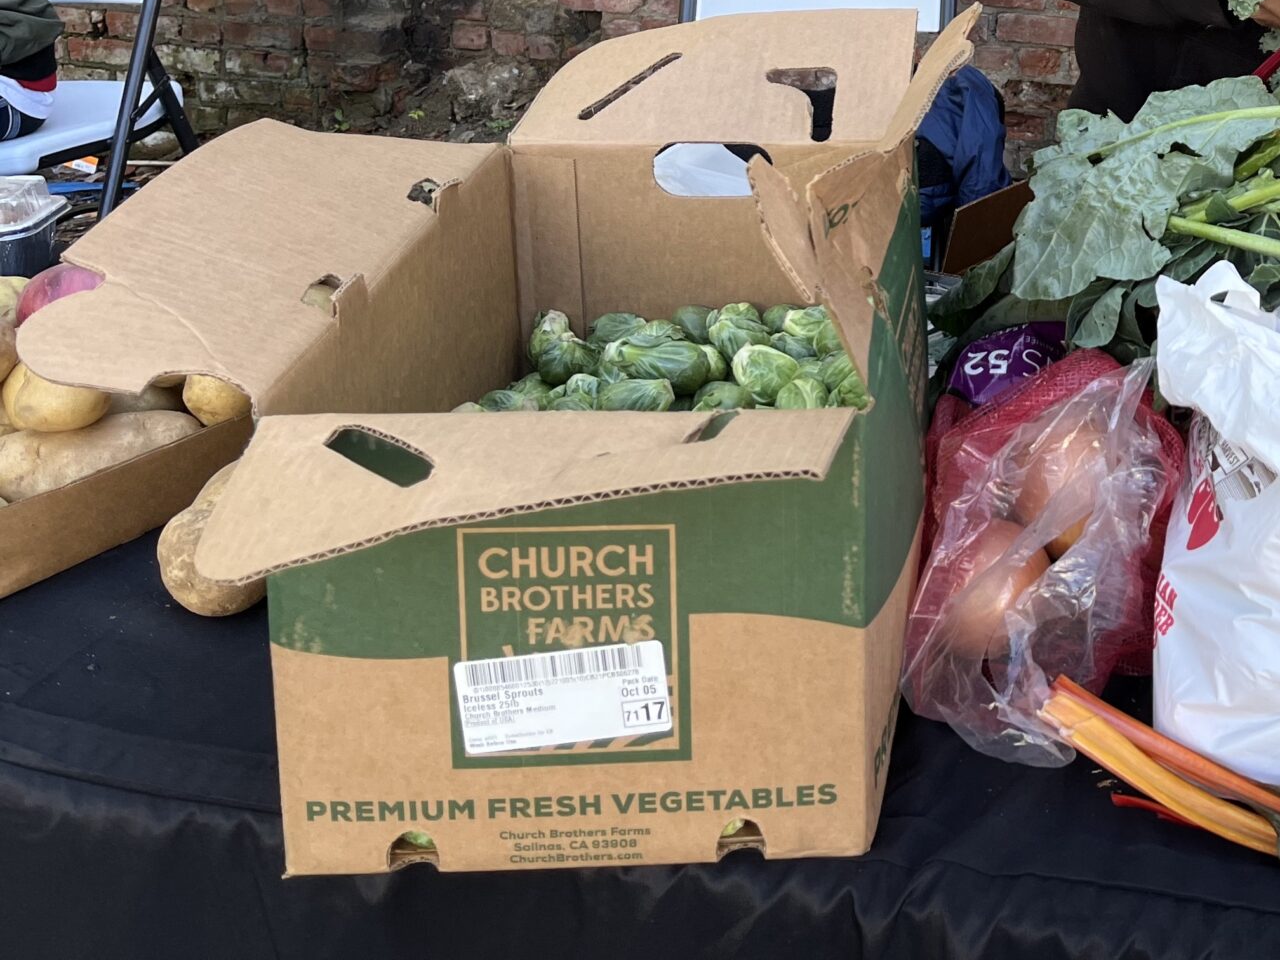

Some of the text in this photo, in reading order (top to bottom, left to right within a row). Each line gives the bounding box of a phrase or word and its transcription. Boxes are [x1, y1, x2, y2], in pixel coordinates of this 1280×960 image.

[964, 349, 1010, 375] 52
[478, 544, 654, 579] CHURCH
[480, 583, 655, 612] BROTHERS
[527, 614, 655, 645] FARMS
[462, 688, 543, 704] Brussel Sprouts
[621, 685, 657, 697] Oct 05
[464, 700, 520, 713] Iceless 25lb
[306, 783, 838, 822] PREMIUM FRESH VEGETABLES
[499, 827, 651, 840] Church Brothers Farms
[569, 841, 588, 850] CA
[592, 839, 637, 849] 93908
[510, 852, 643, 863] ChurchBrothers.com
